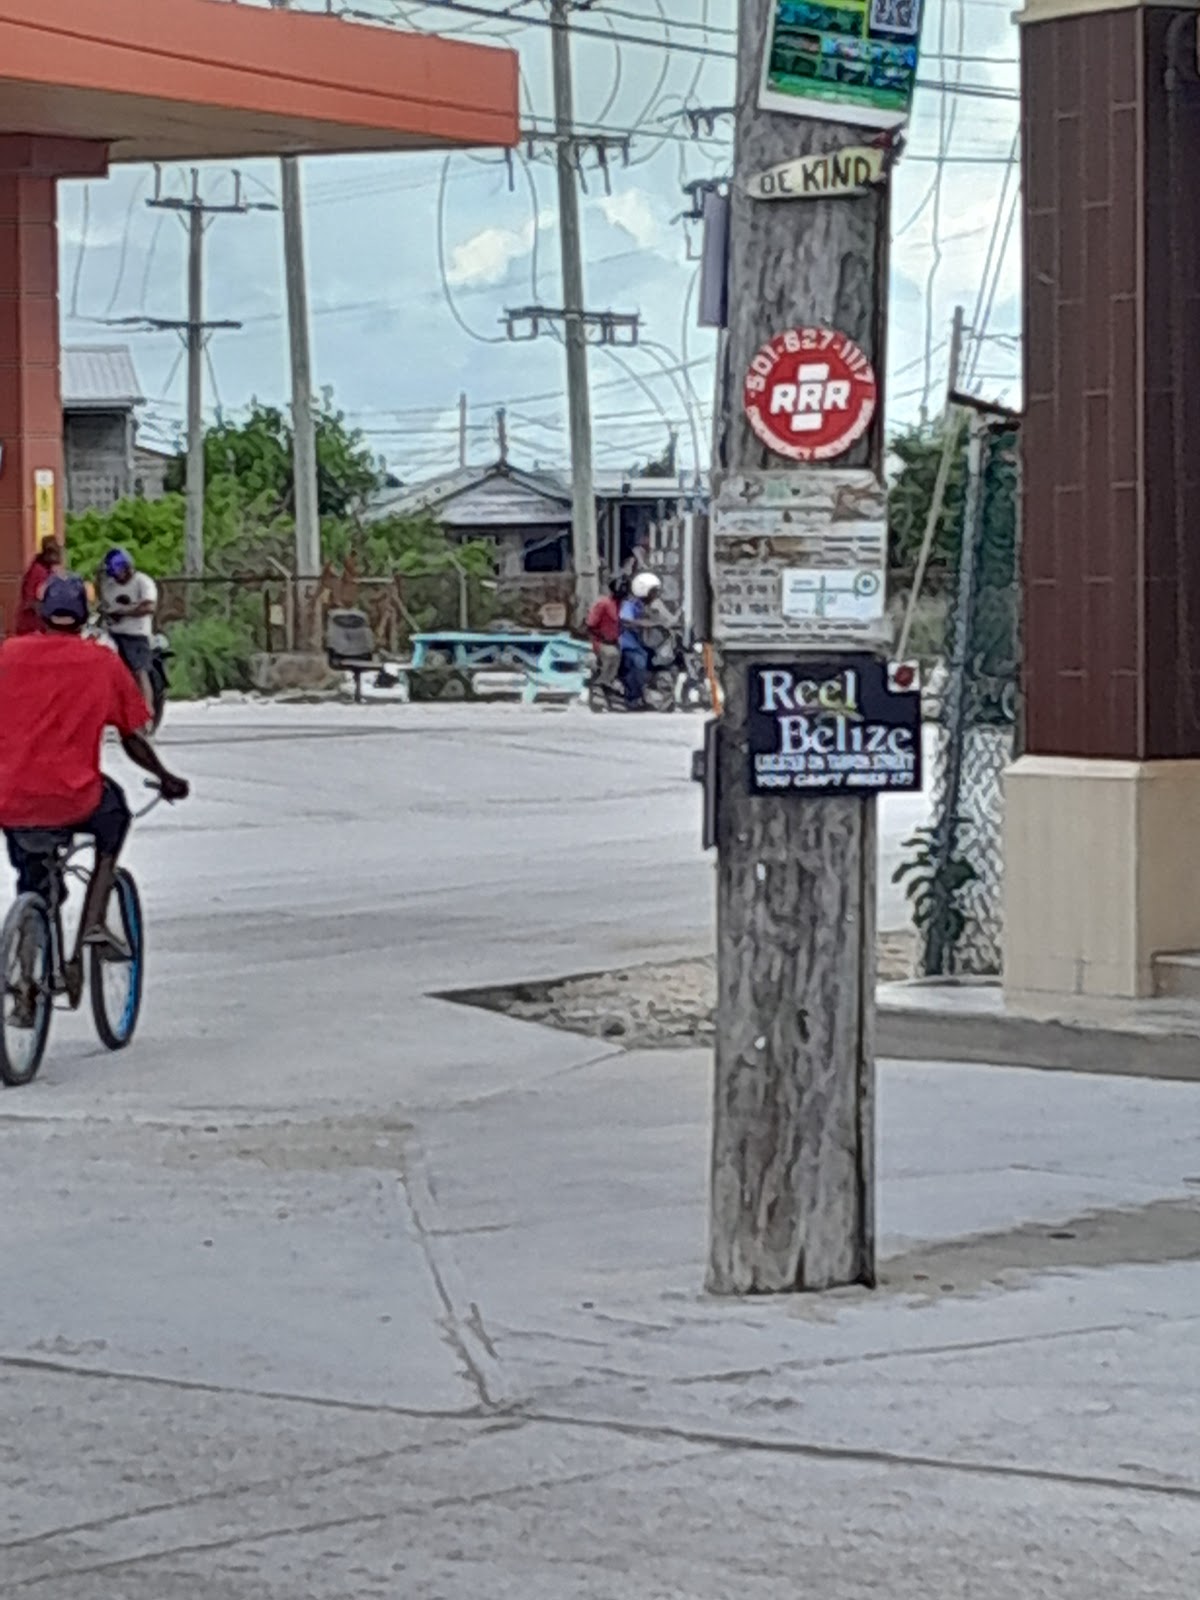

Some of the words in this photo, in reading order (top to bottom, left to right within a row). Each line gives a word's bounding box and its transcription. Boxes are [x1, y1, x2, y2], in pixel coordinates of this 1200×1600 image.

[801, 153, 872, 193] KIND
[770, 379, 850, 415] RRR
[758, 669, 858, 712] Reel
[778, 714, 913, 755] Belize
